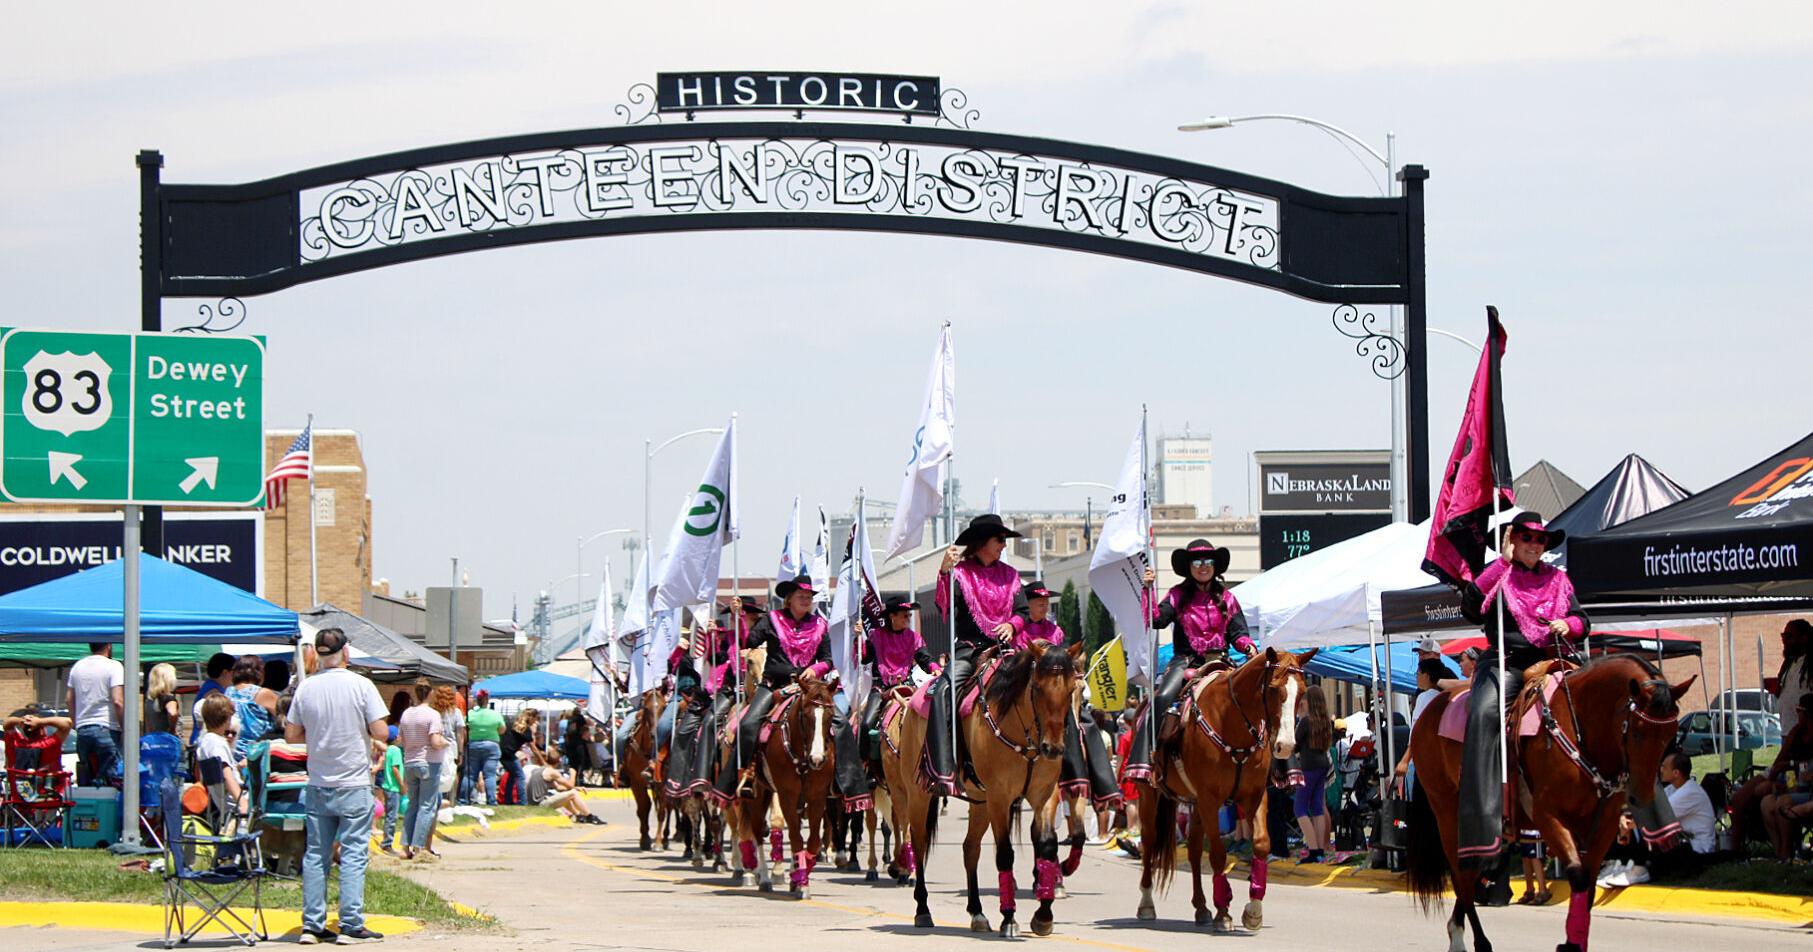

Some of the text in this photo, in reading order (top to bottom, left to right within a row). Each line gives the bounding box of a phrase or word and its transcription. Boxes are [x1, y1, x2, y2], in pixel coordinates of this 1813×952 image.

[677, 75, 919, 111] HISTORIC
[318, 143, 1264, 255] CANTEEN DISTRICT
[148, 355, 249, 388] Dewey
[32, 368, 101, 415] 83
[150, 394, 246, 420] Street
[1316, 492, 1355, 503] BANK
[1281, 530, 1311, 543] 1:18
[139, 545, 232, 563] NKER
[1643, 542, 1798, 577] firstinterstate.com
